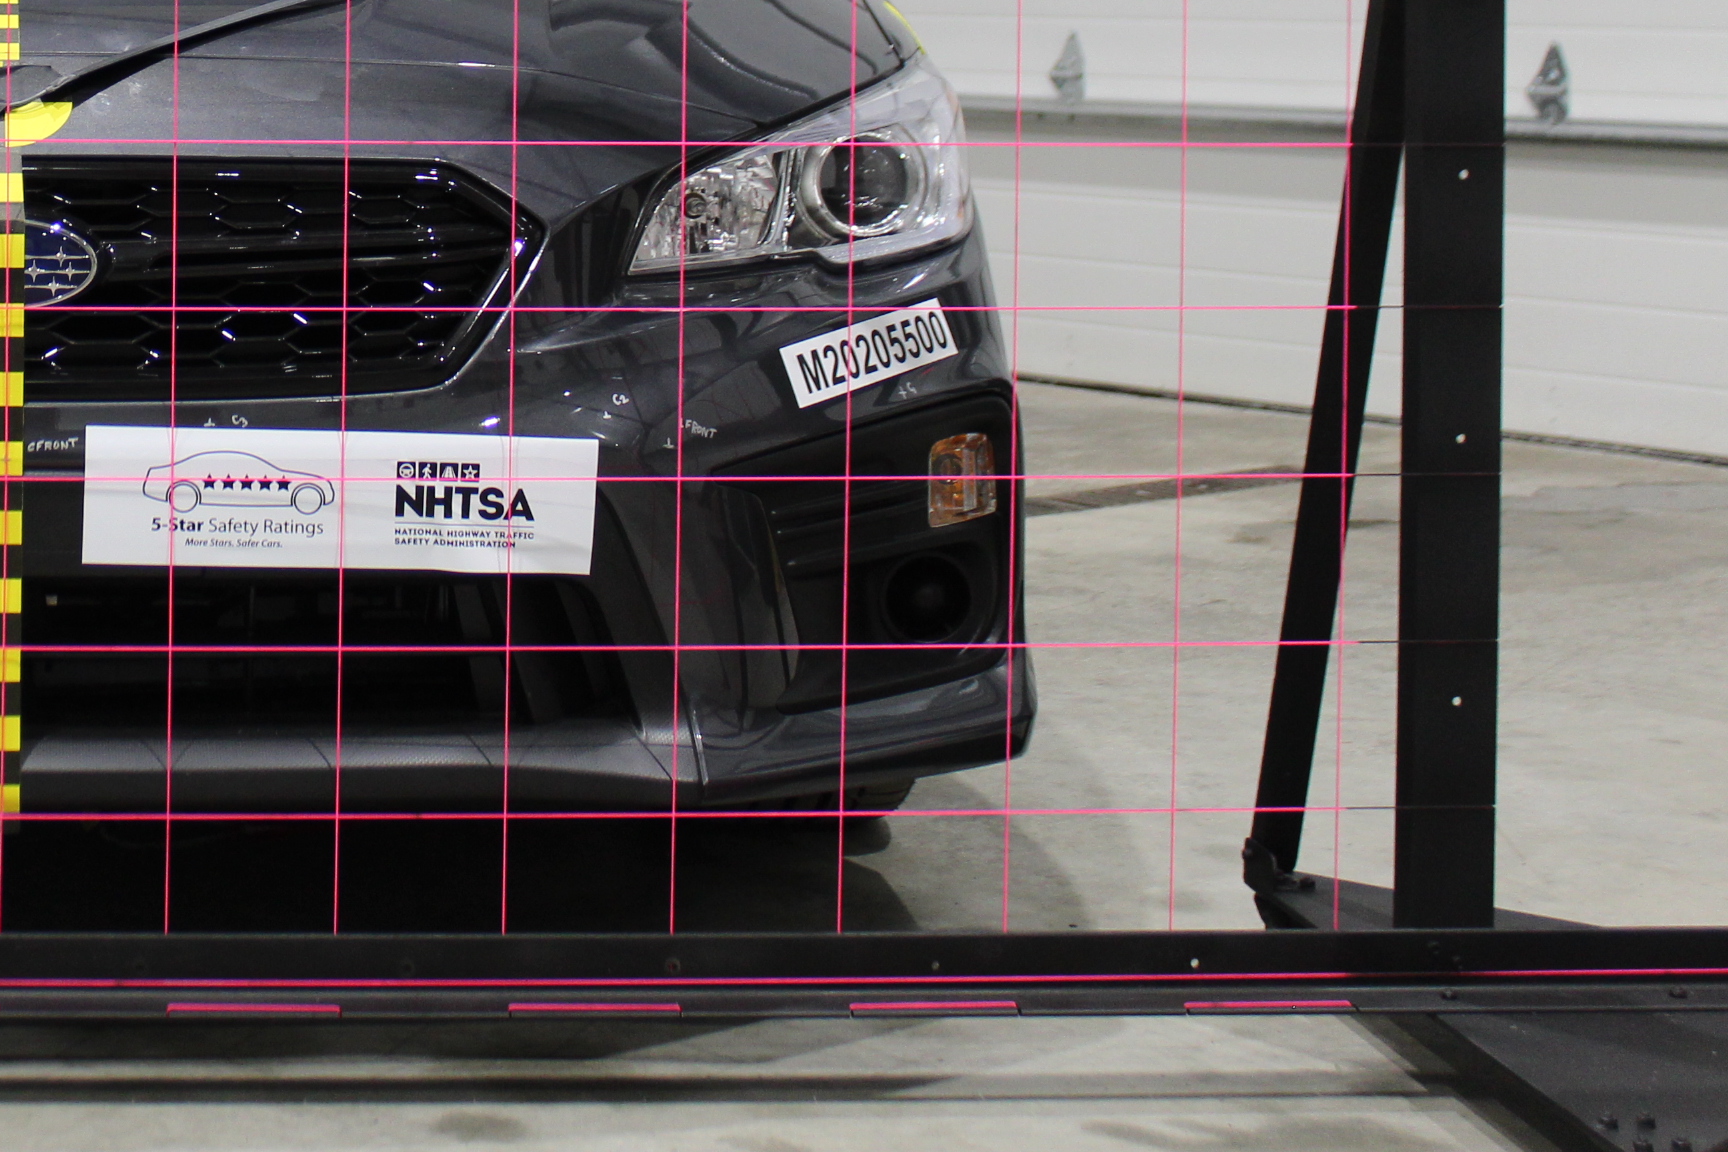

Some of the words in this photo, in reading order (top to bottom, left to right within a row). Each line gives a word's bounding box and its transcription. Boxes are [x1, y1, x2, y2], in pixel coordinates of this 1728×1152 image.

[796, 311, 948, 394] M20205500
[395, 484, 535, 521] NHTSA
[151, 517, 204, 532] 5-Star
[208, 518, 259, 536] Safety
[264, 519, 324, 538] Ratings
[394, 528, 444, 537] NATIONAL
[447, 530, 491, 538] HIGHWAY
[494, 531, 535, 540] TRAFFIC
[185, 538, 208, 547] More
[210, 538, 234, 547] Stars.
[236, 538, 259, 548] Safer
[261, 539, 283, 548] Cars.
[394, 537, 430, 546] SAFETY
[433, 538, 516, 548] ADMINISTRATION
